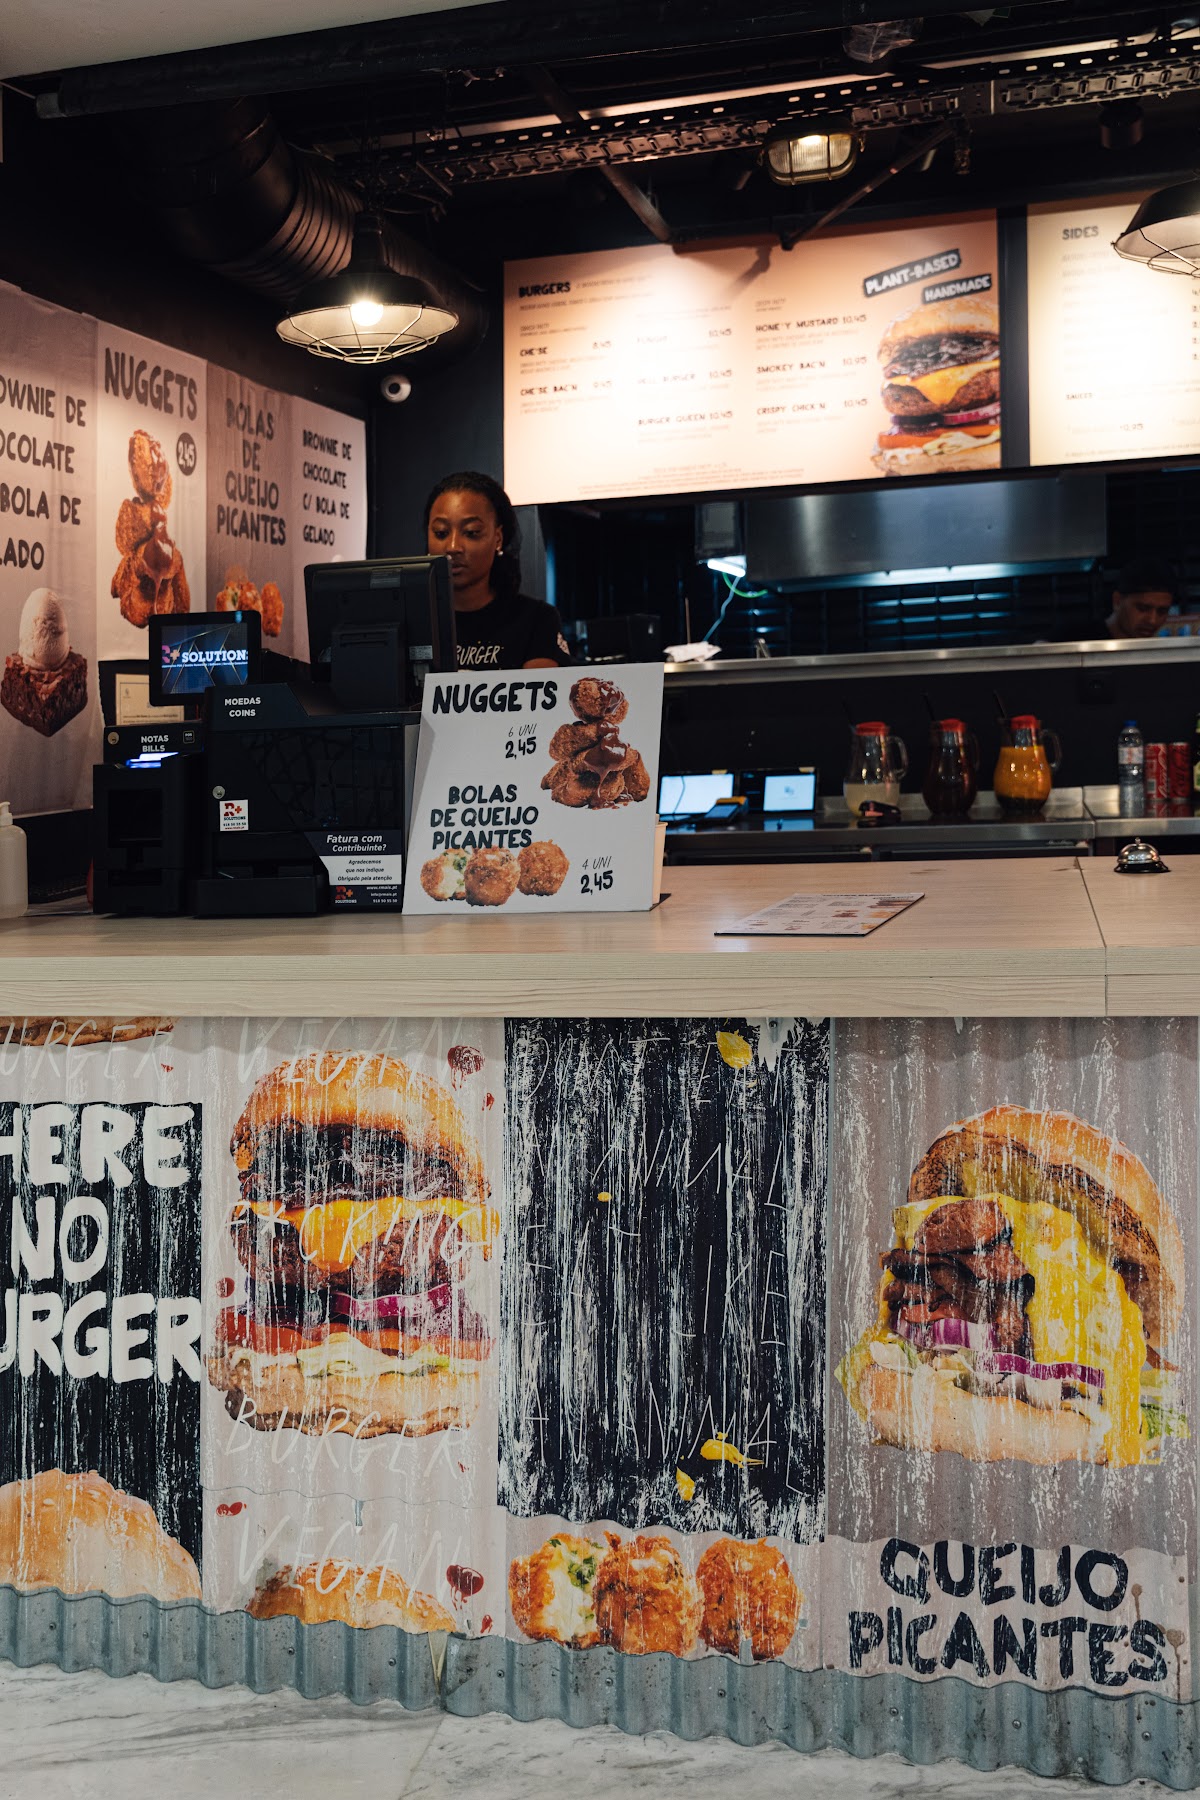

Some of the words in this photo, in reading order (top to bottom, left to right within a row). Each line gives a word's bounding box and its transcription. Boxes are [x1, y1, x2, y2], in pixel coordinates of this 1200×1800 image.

[1062, 226, 1099, 240] SIDES
[865, 253, 959, 295] PLANT-BASED
[518, 281, 571, 298] BURGERS
[924, 276, 991, 301] HANDMADE
[796, 317, 839, 328] MUSTARD
[756, 363, 793, 374] SMOKEY
[104, 347, 198, 421] NUGGETS
[65, 395, 87, 427] DE
[226, 398, 275, 441] BOLAS
[756, 405, 786, 416] CRISPY
[178, 441, 196, 469] 2,45
[242, 439, 261, 472] DE
[303, 429, 338, 457] BROWNIE
[342, 443, 352, 461] DE
[303, 461, 347, 489] CHOCOLATE
[225, 470, 280, 511] QUEIJO
[0, 482, 50, 520] BOLA
[60, 495, 82, 526] DE
[303, 493, 313, 511] C/
[316, 496, 337, 517] BOLA
[340, 502, 350, 519] DE
[217, 504, 287, 546] PICANTES
[303, 524, 336, 547] GELADO
[0, 537, 45, 570] ADO
[182, 649, 248, 663] SOLUTION
[224, 697, 261, 706] MOEDAS
[432, 681, 558, 714] NUGGETS
[229, 709, 256, 717] COINS
[141, 735, 169, 743] NOTAS
[508, 727, 514, 737] 6
[518, 723, 538, 736] UNI
[505, 736, 537, 759] 2,45
[448, 784, 518, 805] BOLAS
[430, 808, 458, 827] DE
[460, 806, 539, 827] QUEIJO
[326, 834, 358, 843] Fatura
[361, 835, 382, 843] com
[332, 844, 387, 852] Contribuinte?
[432, 828, 532, 850] PICANTES
[582, 859, 589, 869] 4
[592, 855, 612, 869] UNI
[580, 870, 614, 894] 2,45
[237, 1017, 462, 1090] VEGAN
[11, 1196, 109, 1283] NO
[224, 1394, 467, 1480] BURGER
[613, 1378, 803, 1495] ANIMAL
[238, 1515, 462, 1608] VEGAN
[880, 1537, 1129, 1612] QUEIJO
[849, 1606, 1168, 1687] PICANTES
